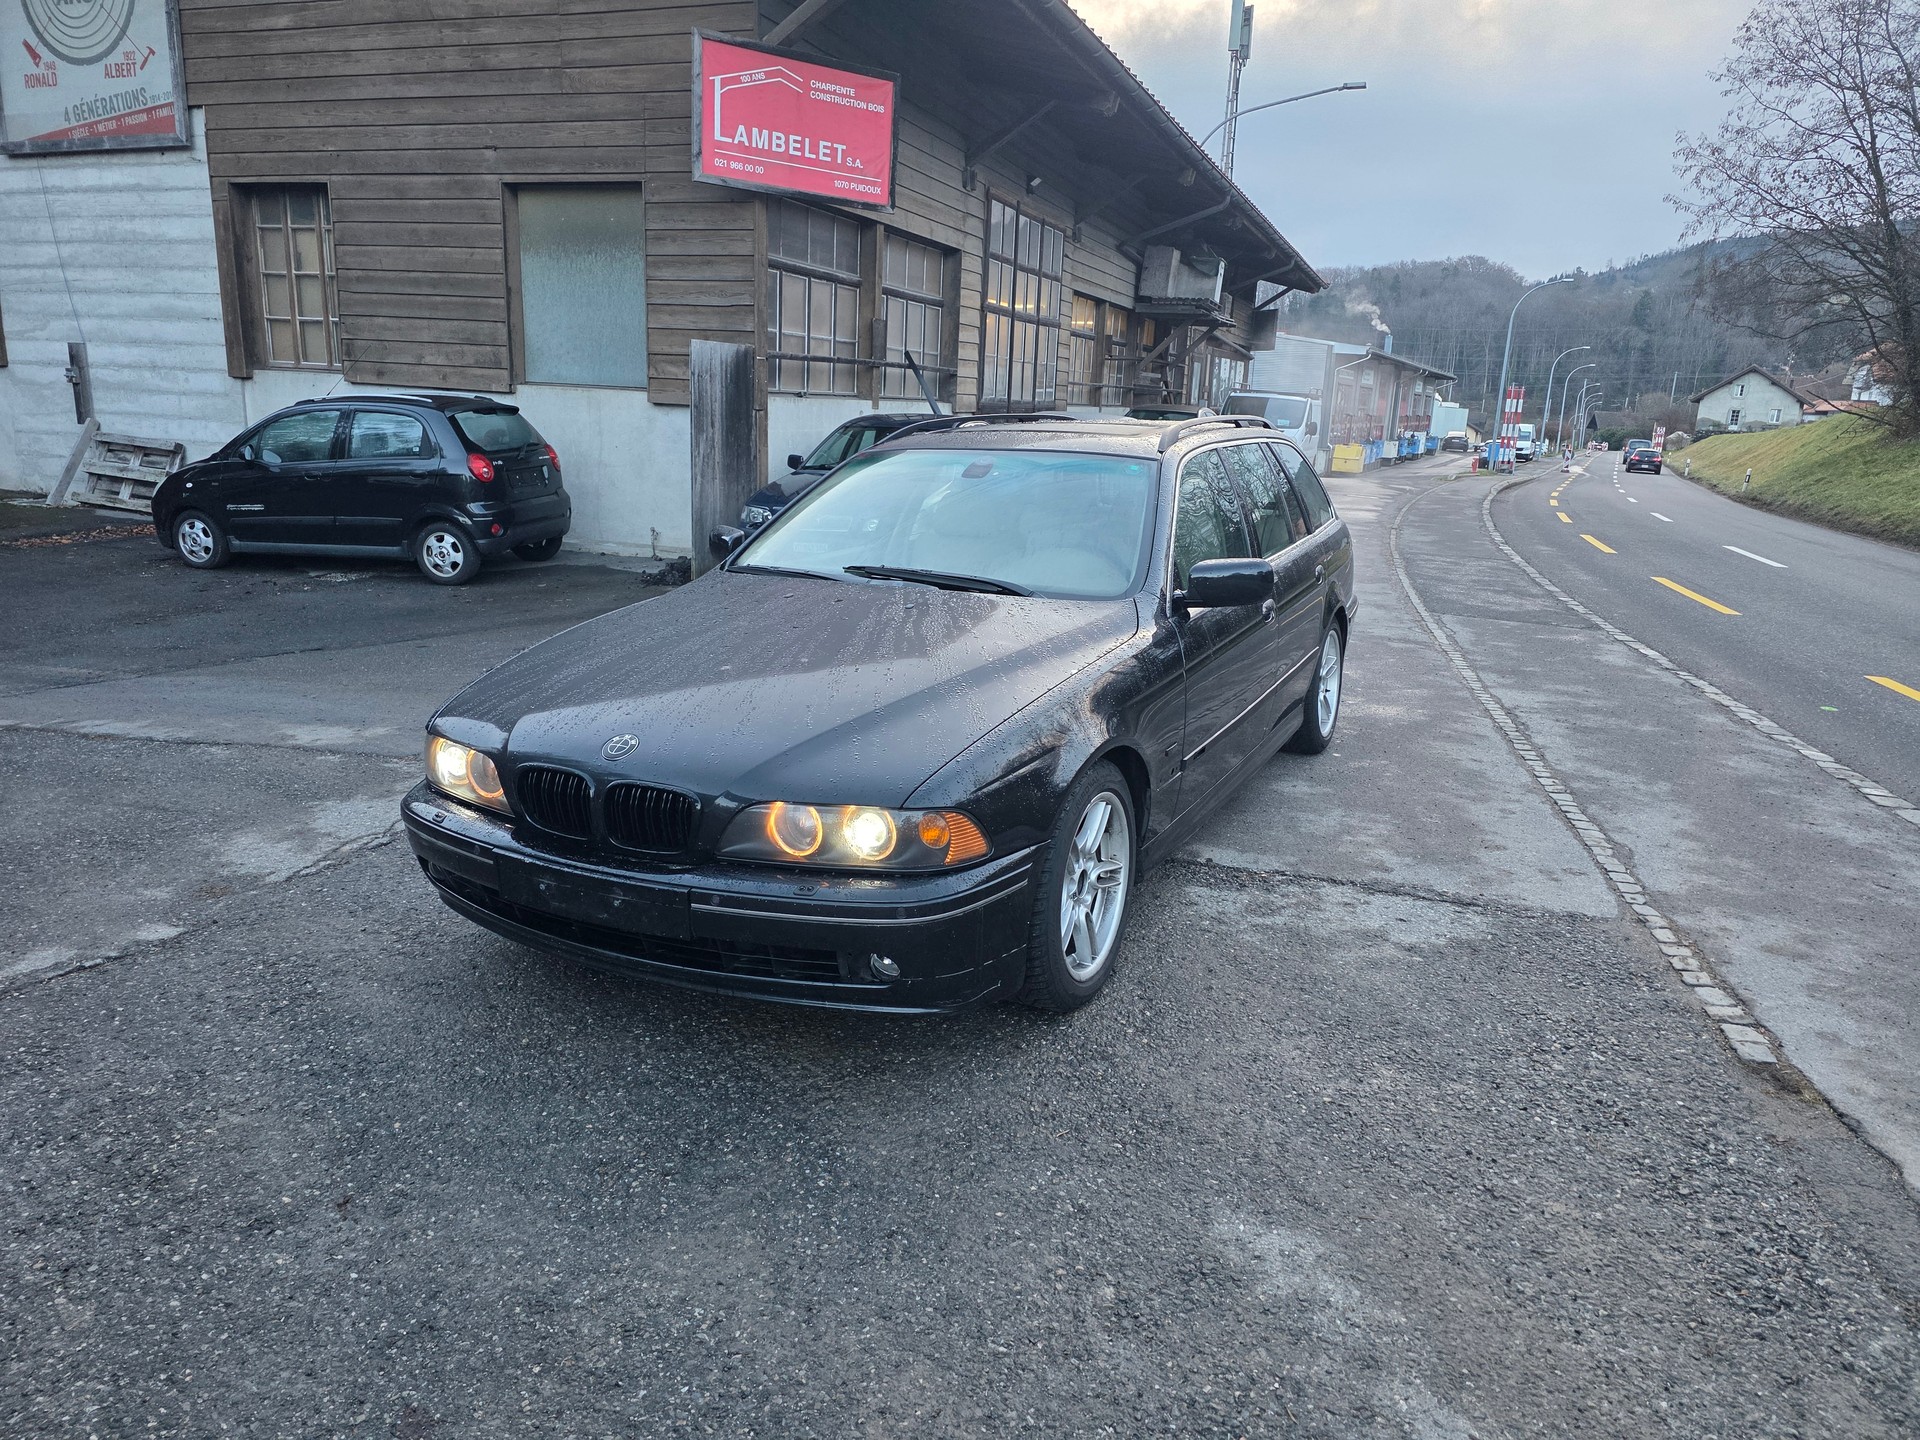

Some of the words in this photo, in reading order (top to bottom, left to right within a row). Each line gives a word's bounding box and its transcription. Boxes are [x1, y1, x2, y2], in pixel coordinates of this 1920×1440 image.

[123, 51, 136, 61] 1922
[104, 62, 137, 79] ALBERT
[740, 75, 751, 83] 100
[752, 72, 766, 81] ANS
[24, 72, 58, 89] RONALD
[810, 80, 856, 96] CHARPENTE
[64, 106, 71, 125] 4
[72, 87, 148, 122] GÉNÉRATIONS
[149, 91, 172, 105] 1914-201
[810, 90, 867, 110] CONSTRUCTION
[868, 103, 885, 114] BOIS
[98, 120, 117, 132] MÉTIER
[125, 112, 148, 126] PASSION
[156, 105, 175, 118] FAMILL
[714, 158, 727, 168] 021
[730, 161, 743, 171] 966
[745, 164, 754, 173] 00
[755, 165, 764, 174] 00
[846, 157, 864, 168] S.A.
[834, 179, 850, 189] 1070
[850, 182, 882, 195] PUIDOUX
